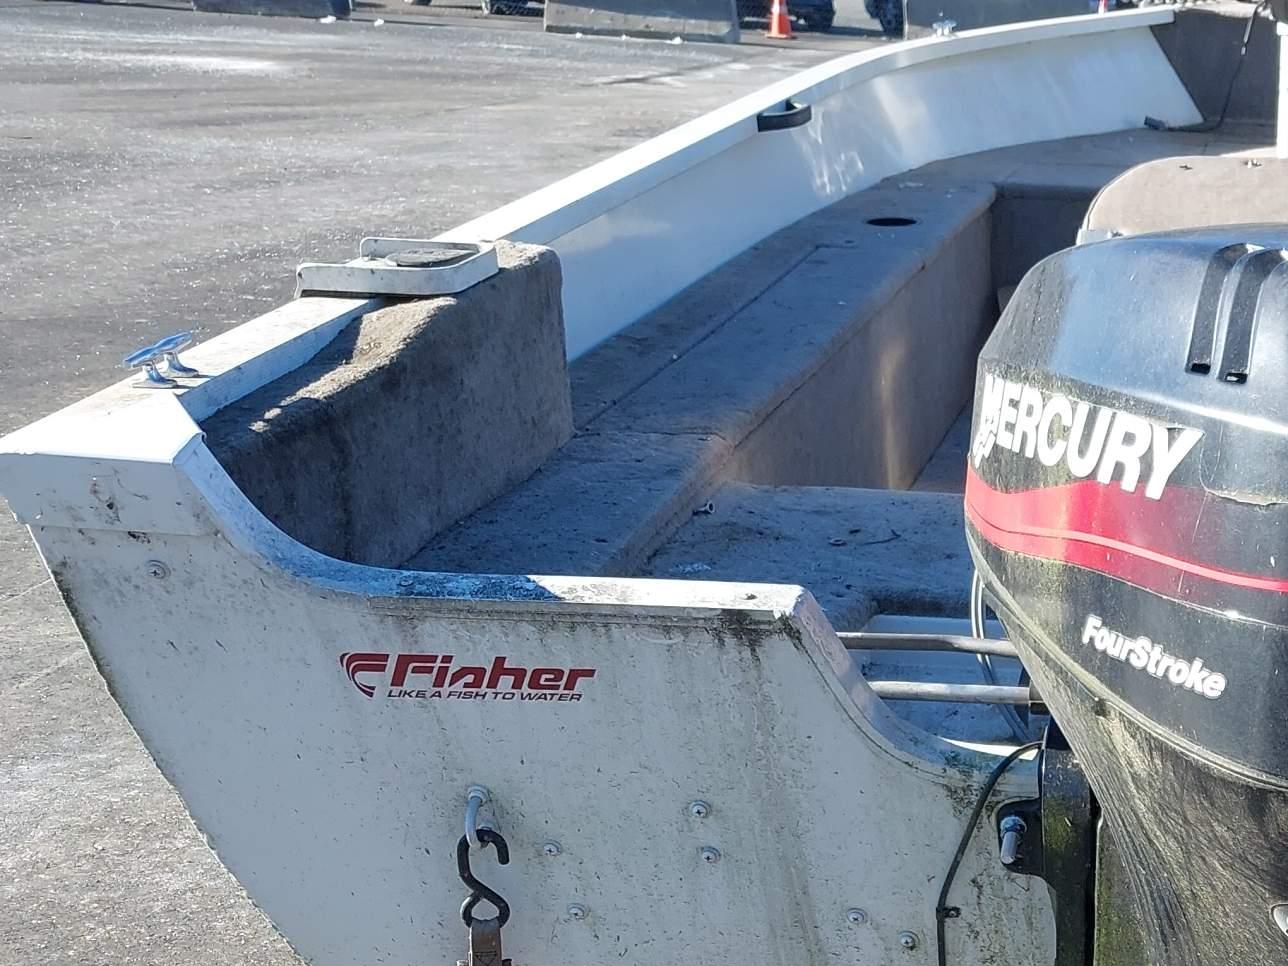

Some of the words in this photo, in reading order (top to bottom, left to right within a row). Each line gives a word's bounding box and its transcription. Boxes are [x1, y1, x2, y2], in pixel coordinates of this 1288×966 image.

[972, 373, 1205, 501] MERCURY
[386, 689, 428, 699] LIKE
[429, 690, 442, 699] A
[446, 690, 488, 700] FISH
[489, 691, 516, 700] TO
[519, 692, 584, 702] WATER
[1081, 613, 1228, 700] FourStroke
